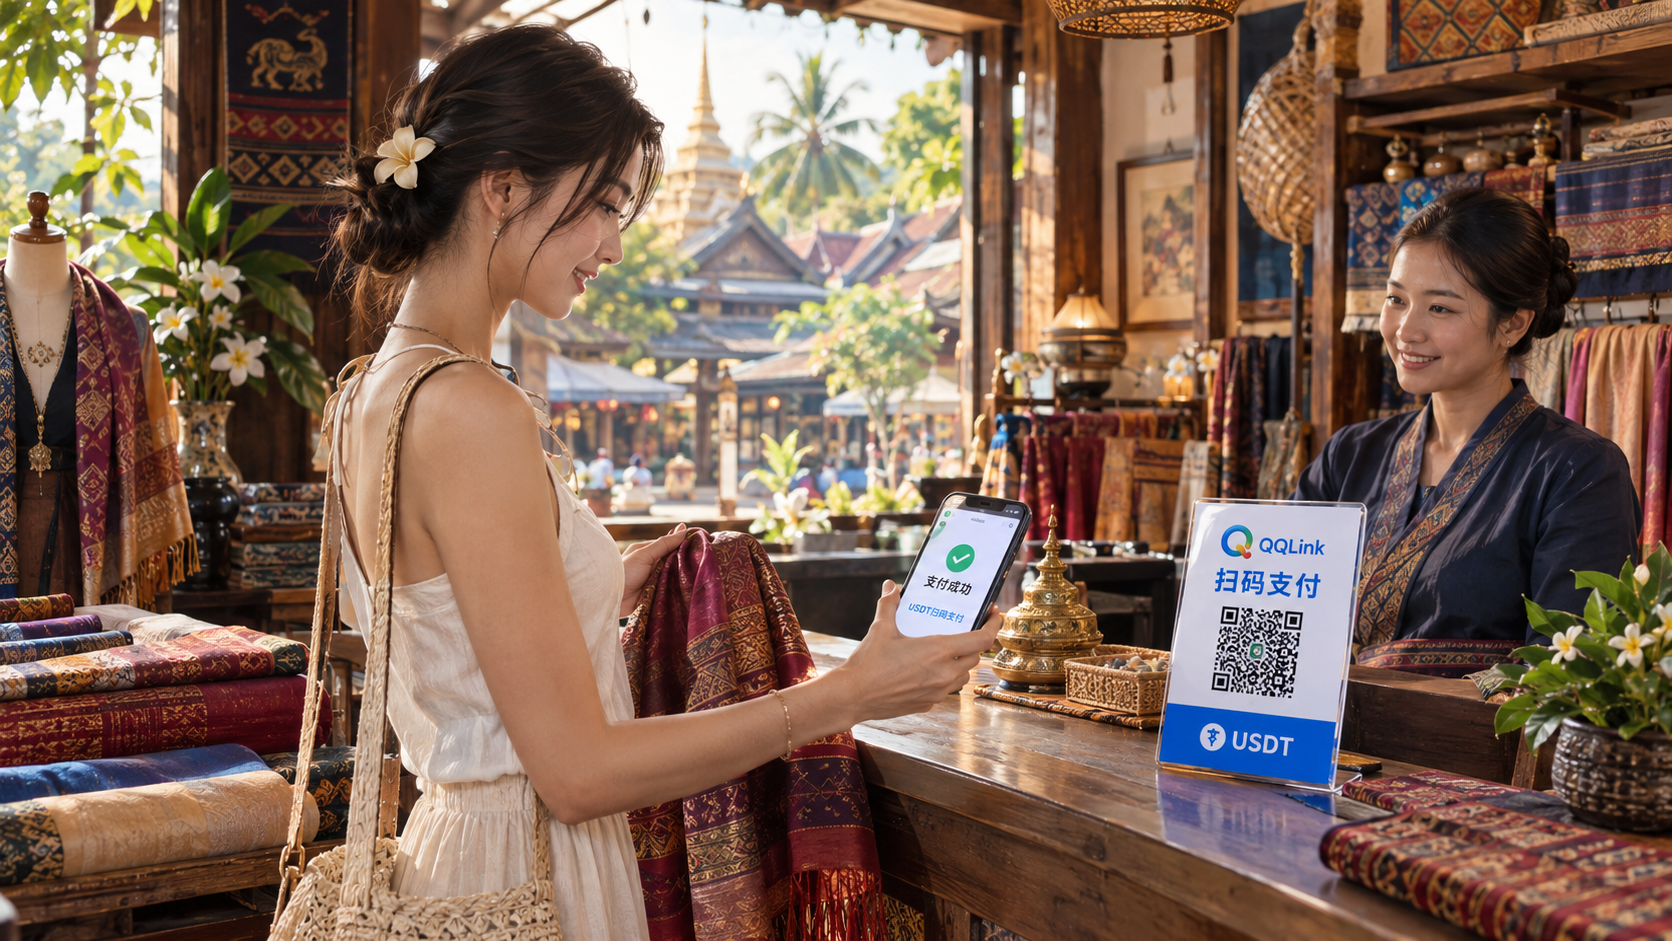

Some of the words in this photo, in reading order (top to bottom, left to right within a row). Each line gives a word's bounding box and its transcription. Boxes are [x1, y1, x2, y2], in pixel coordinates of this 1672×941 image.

[1259, 537, 1326, 556] QQLink
[923, 575, 973, 596] 支付成功
[1215, 568, 1322, 598] 扫码支付
[1232, 730, 1295, 757] USDT
